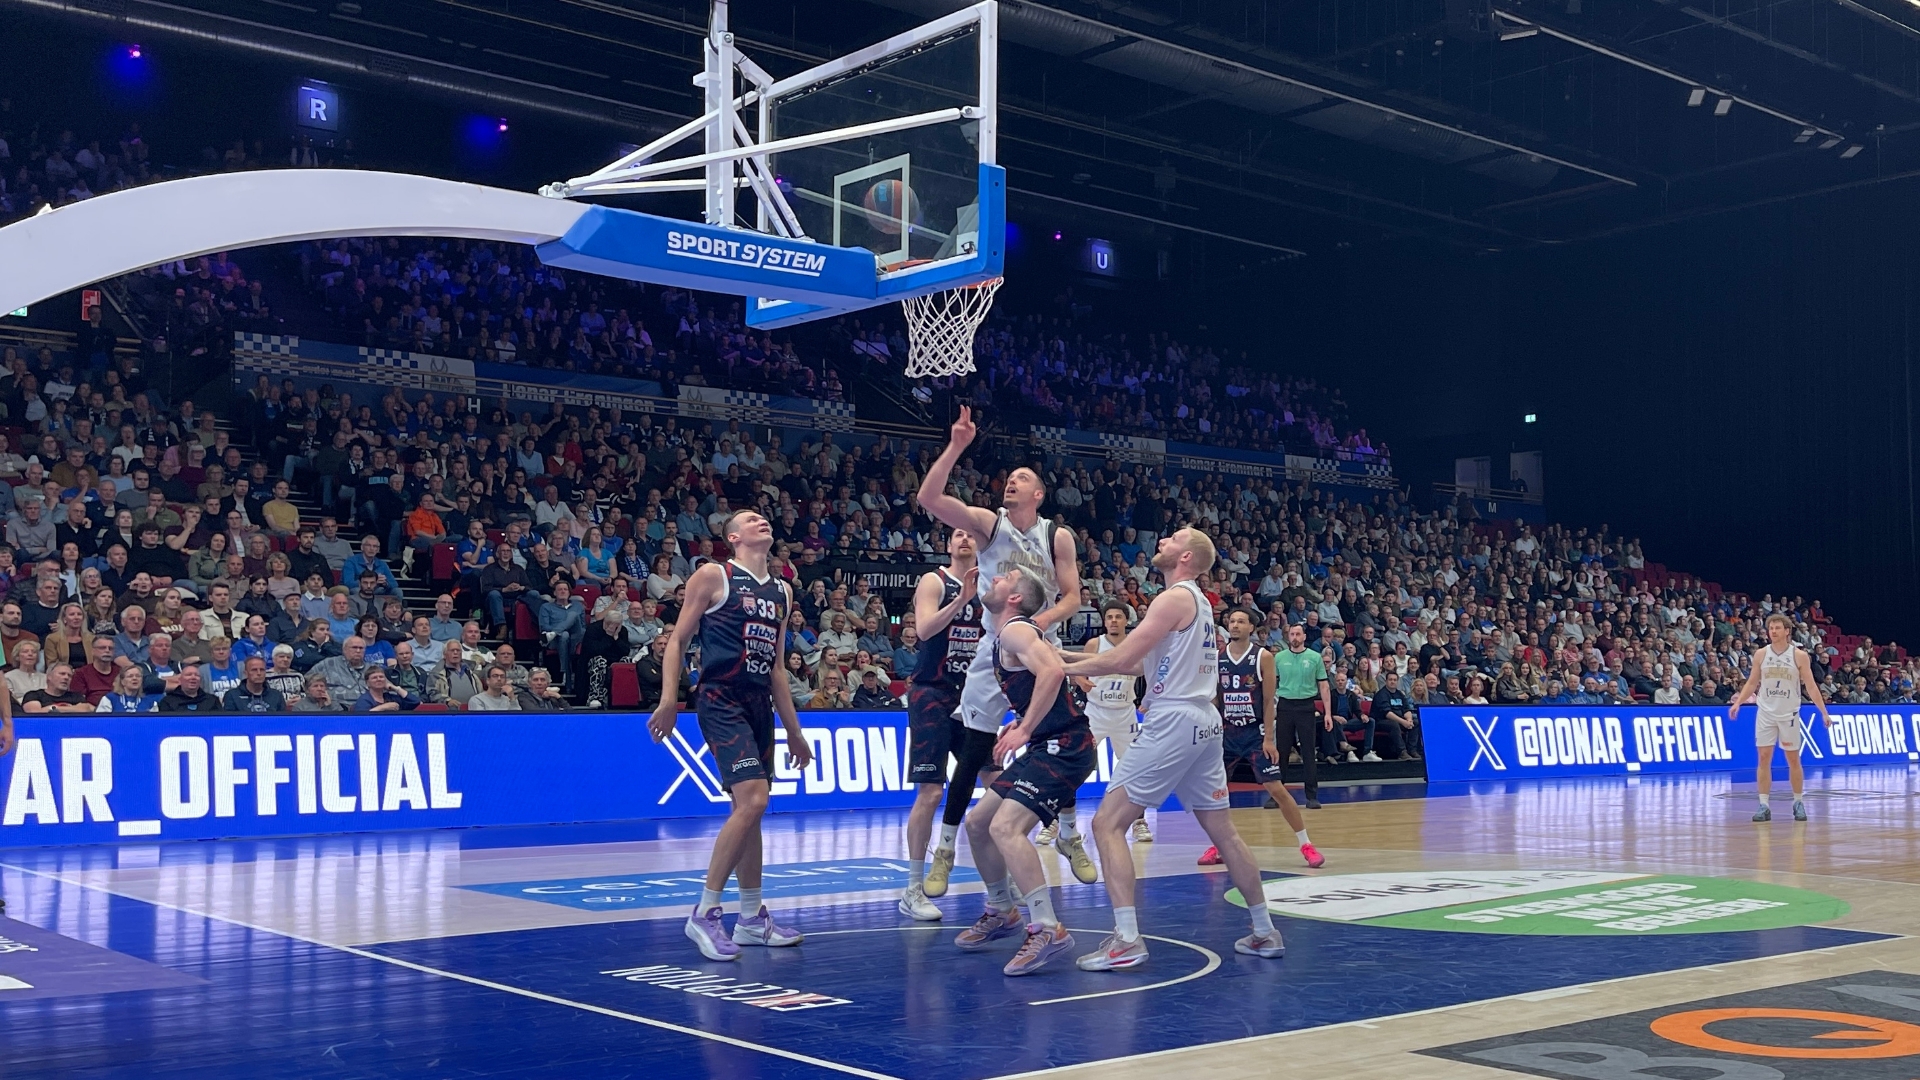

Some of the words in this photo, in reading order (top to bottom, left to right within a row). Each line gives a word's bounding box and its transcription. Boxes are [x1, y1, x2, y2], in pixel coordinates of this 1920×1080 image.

[310, 97, 327, 122] R
[667, 231, 741, 259] SPORT
[741, 243, 827, 272] SYSTEM
[1096, 252, 1108, 270] U
[467, 397, 481, 414] H
[1145, 467, 1153, 477] K
[1488, 501, 1497, 514] M
[756, 598, 776, 620] 33
[964, 604, 974, 621] 9
[747, 624, 777, 641] Hubo
[951, 627, 978, 639] Hubo
[1109, 681, 1122, 691] 11
[1232, 674, 1241, 689] 6
[1775, 680, 1781, 689] 1
[1225, 694, 1250, 702] Hubo
[1789, 719, 1795, 728] 1
[1513, 716, 1732, 771] @DONAR_OFFICIAL
[3, 733, 463, 836] AR_OFFICIAL
[522, 862, 911, 894] cenury
[599, 964, 854, 1012] EXCEPTION
